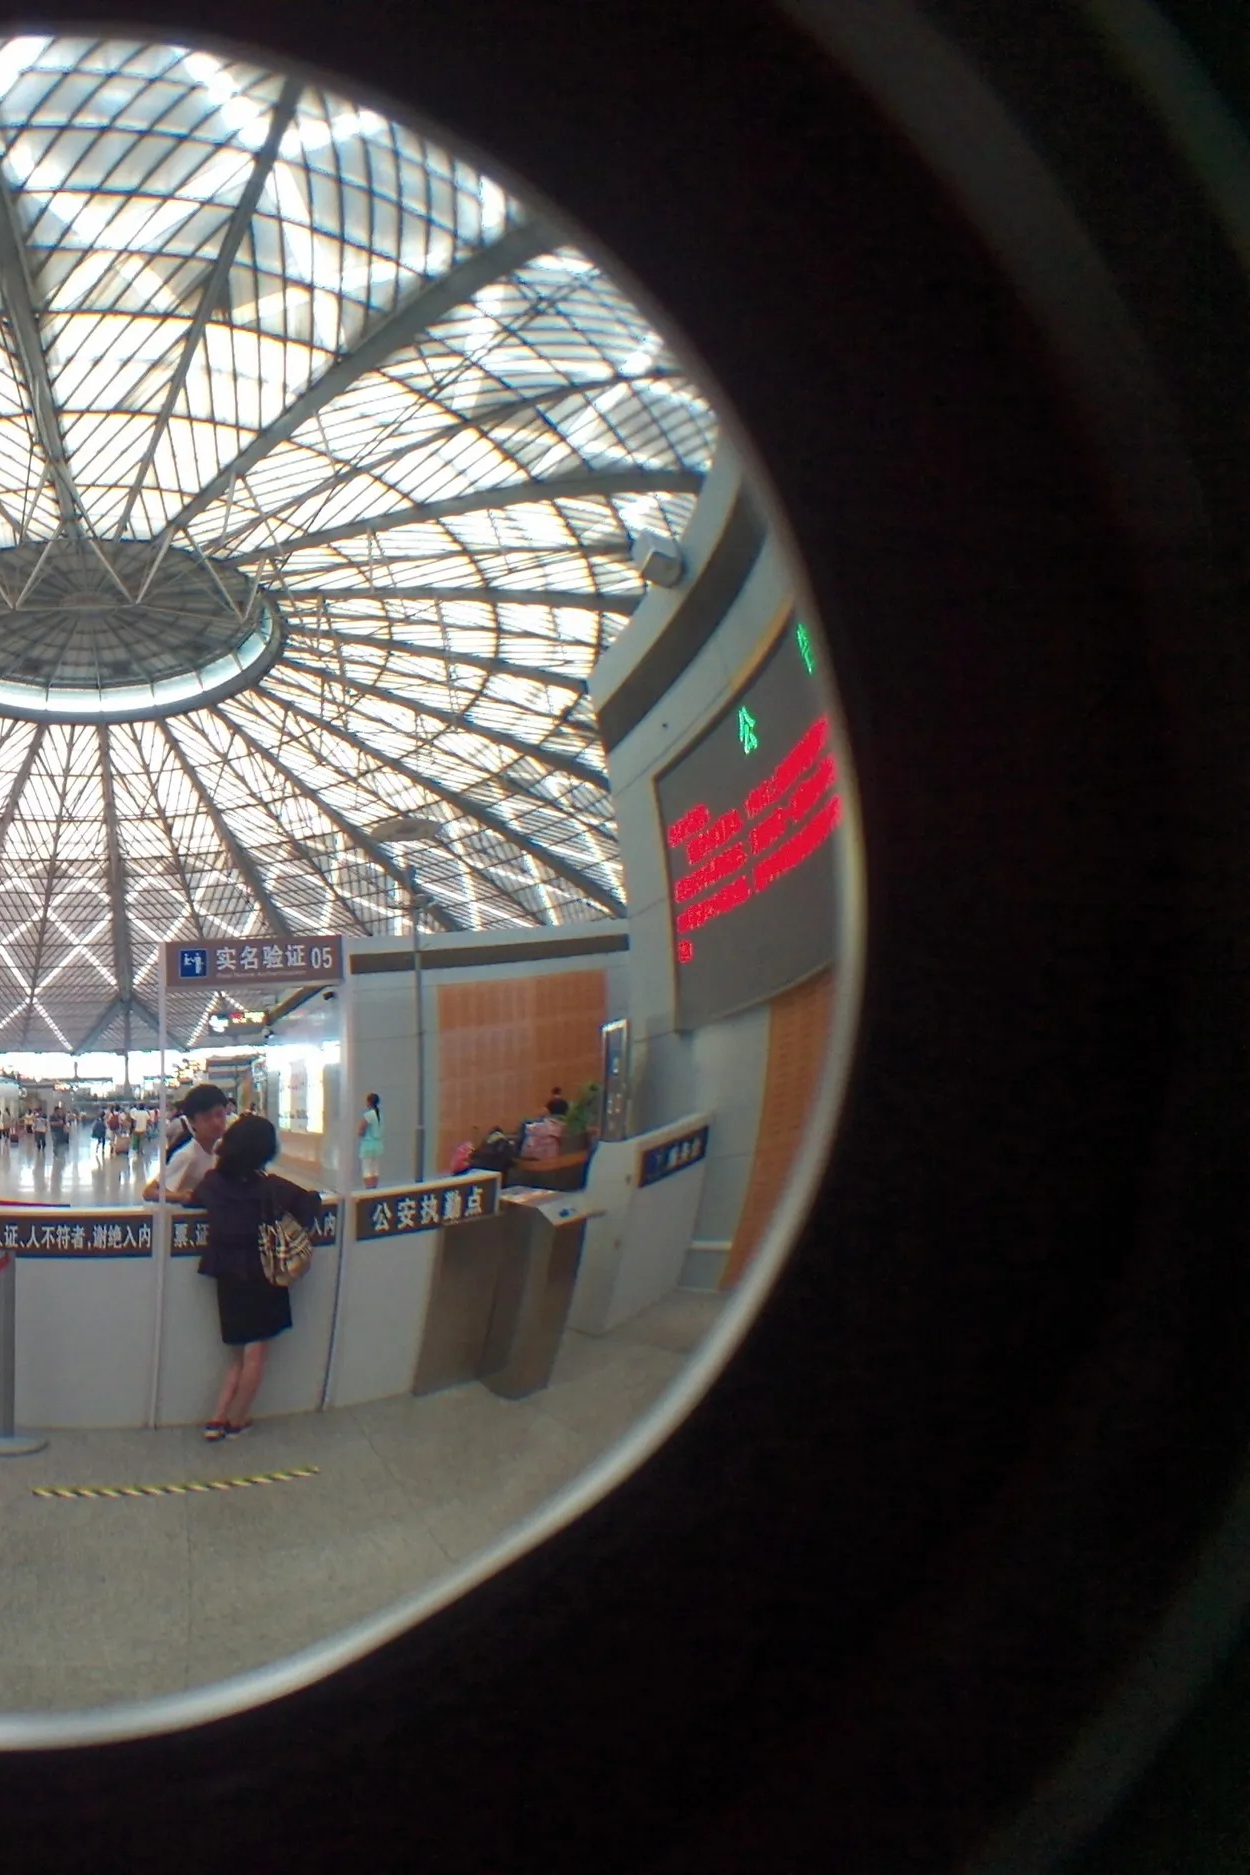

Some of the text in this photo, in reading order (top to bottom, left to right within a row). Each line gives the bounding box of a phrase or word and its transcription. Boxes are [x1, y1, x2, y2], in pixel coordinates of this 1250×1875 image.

[215, 945, 332, 970] 实名验证 05
